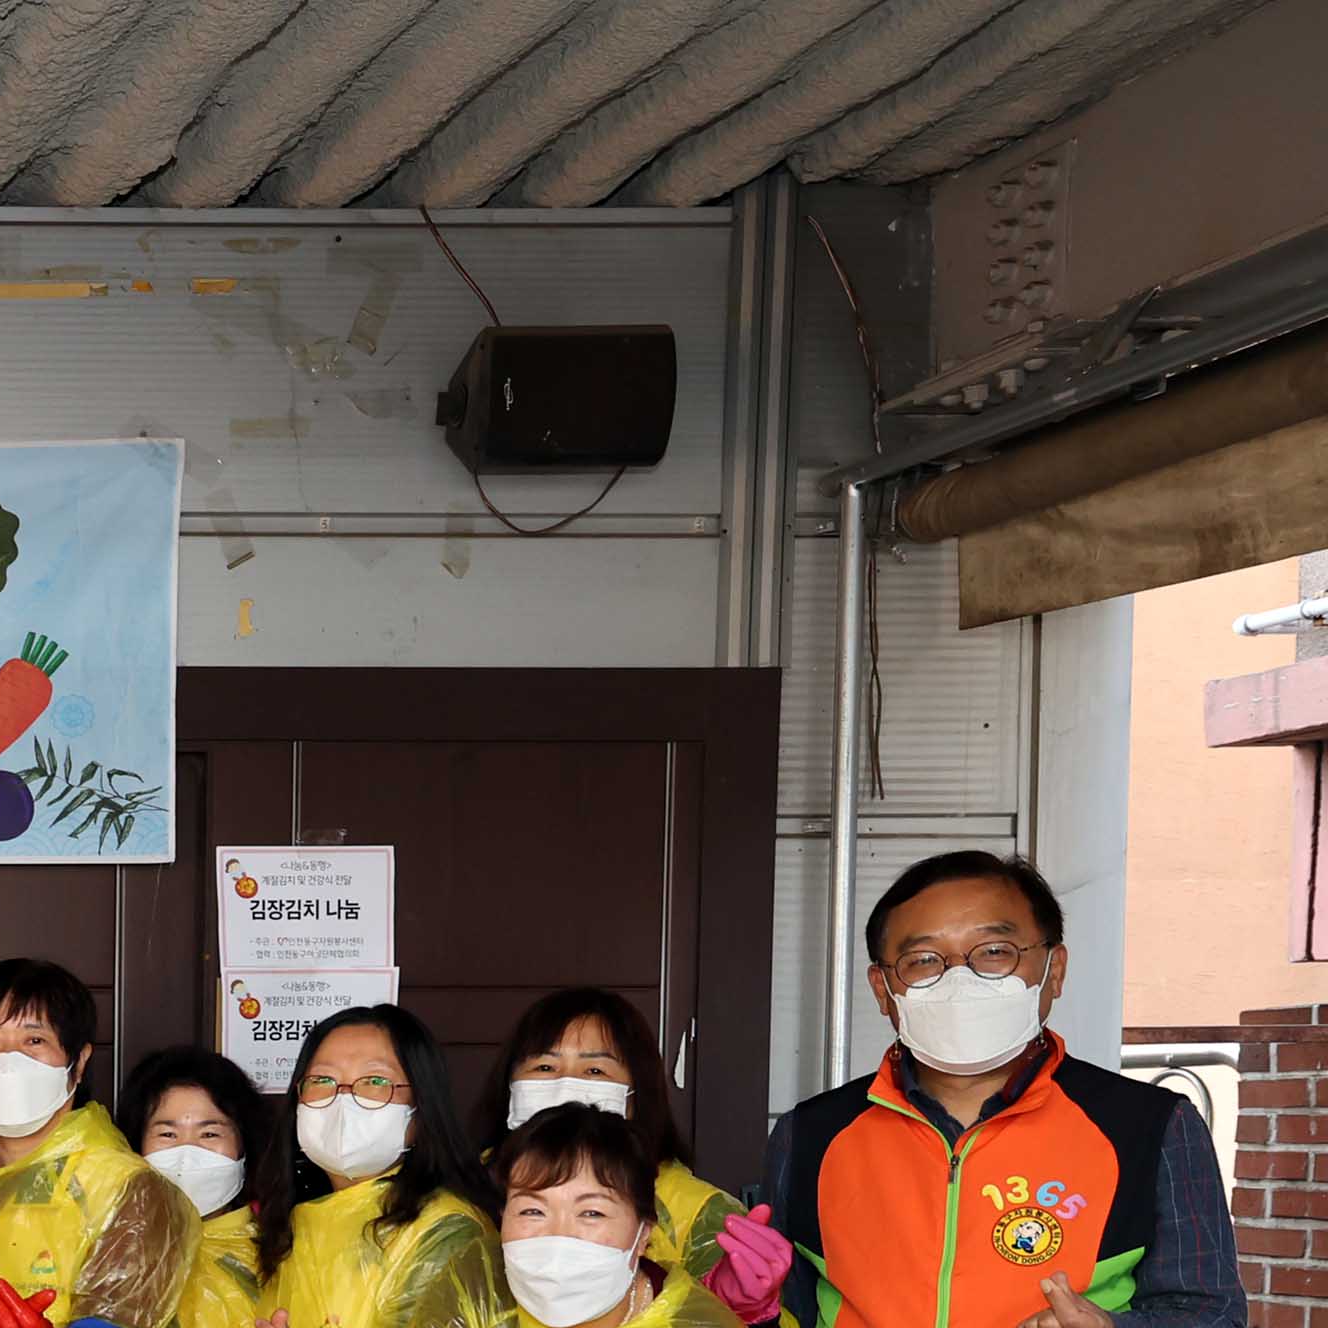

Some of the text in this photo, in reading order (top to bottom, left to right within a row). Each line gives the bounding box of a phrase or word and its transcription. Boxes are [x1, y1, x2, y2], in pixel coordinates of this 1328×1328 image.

[249, 899, 361, 920] 김장김치 나눔
[981, 1175, 1088, 1220] 1365
